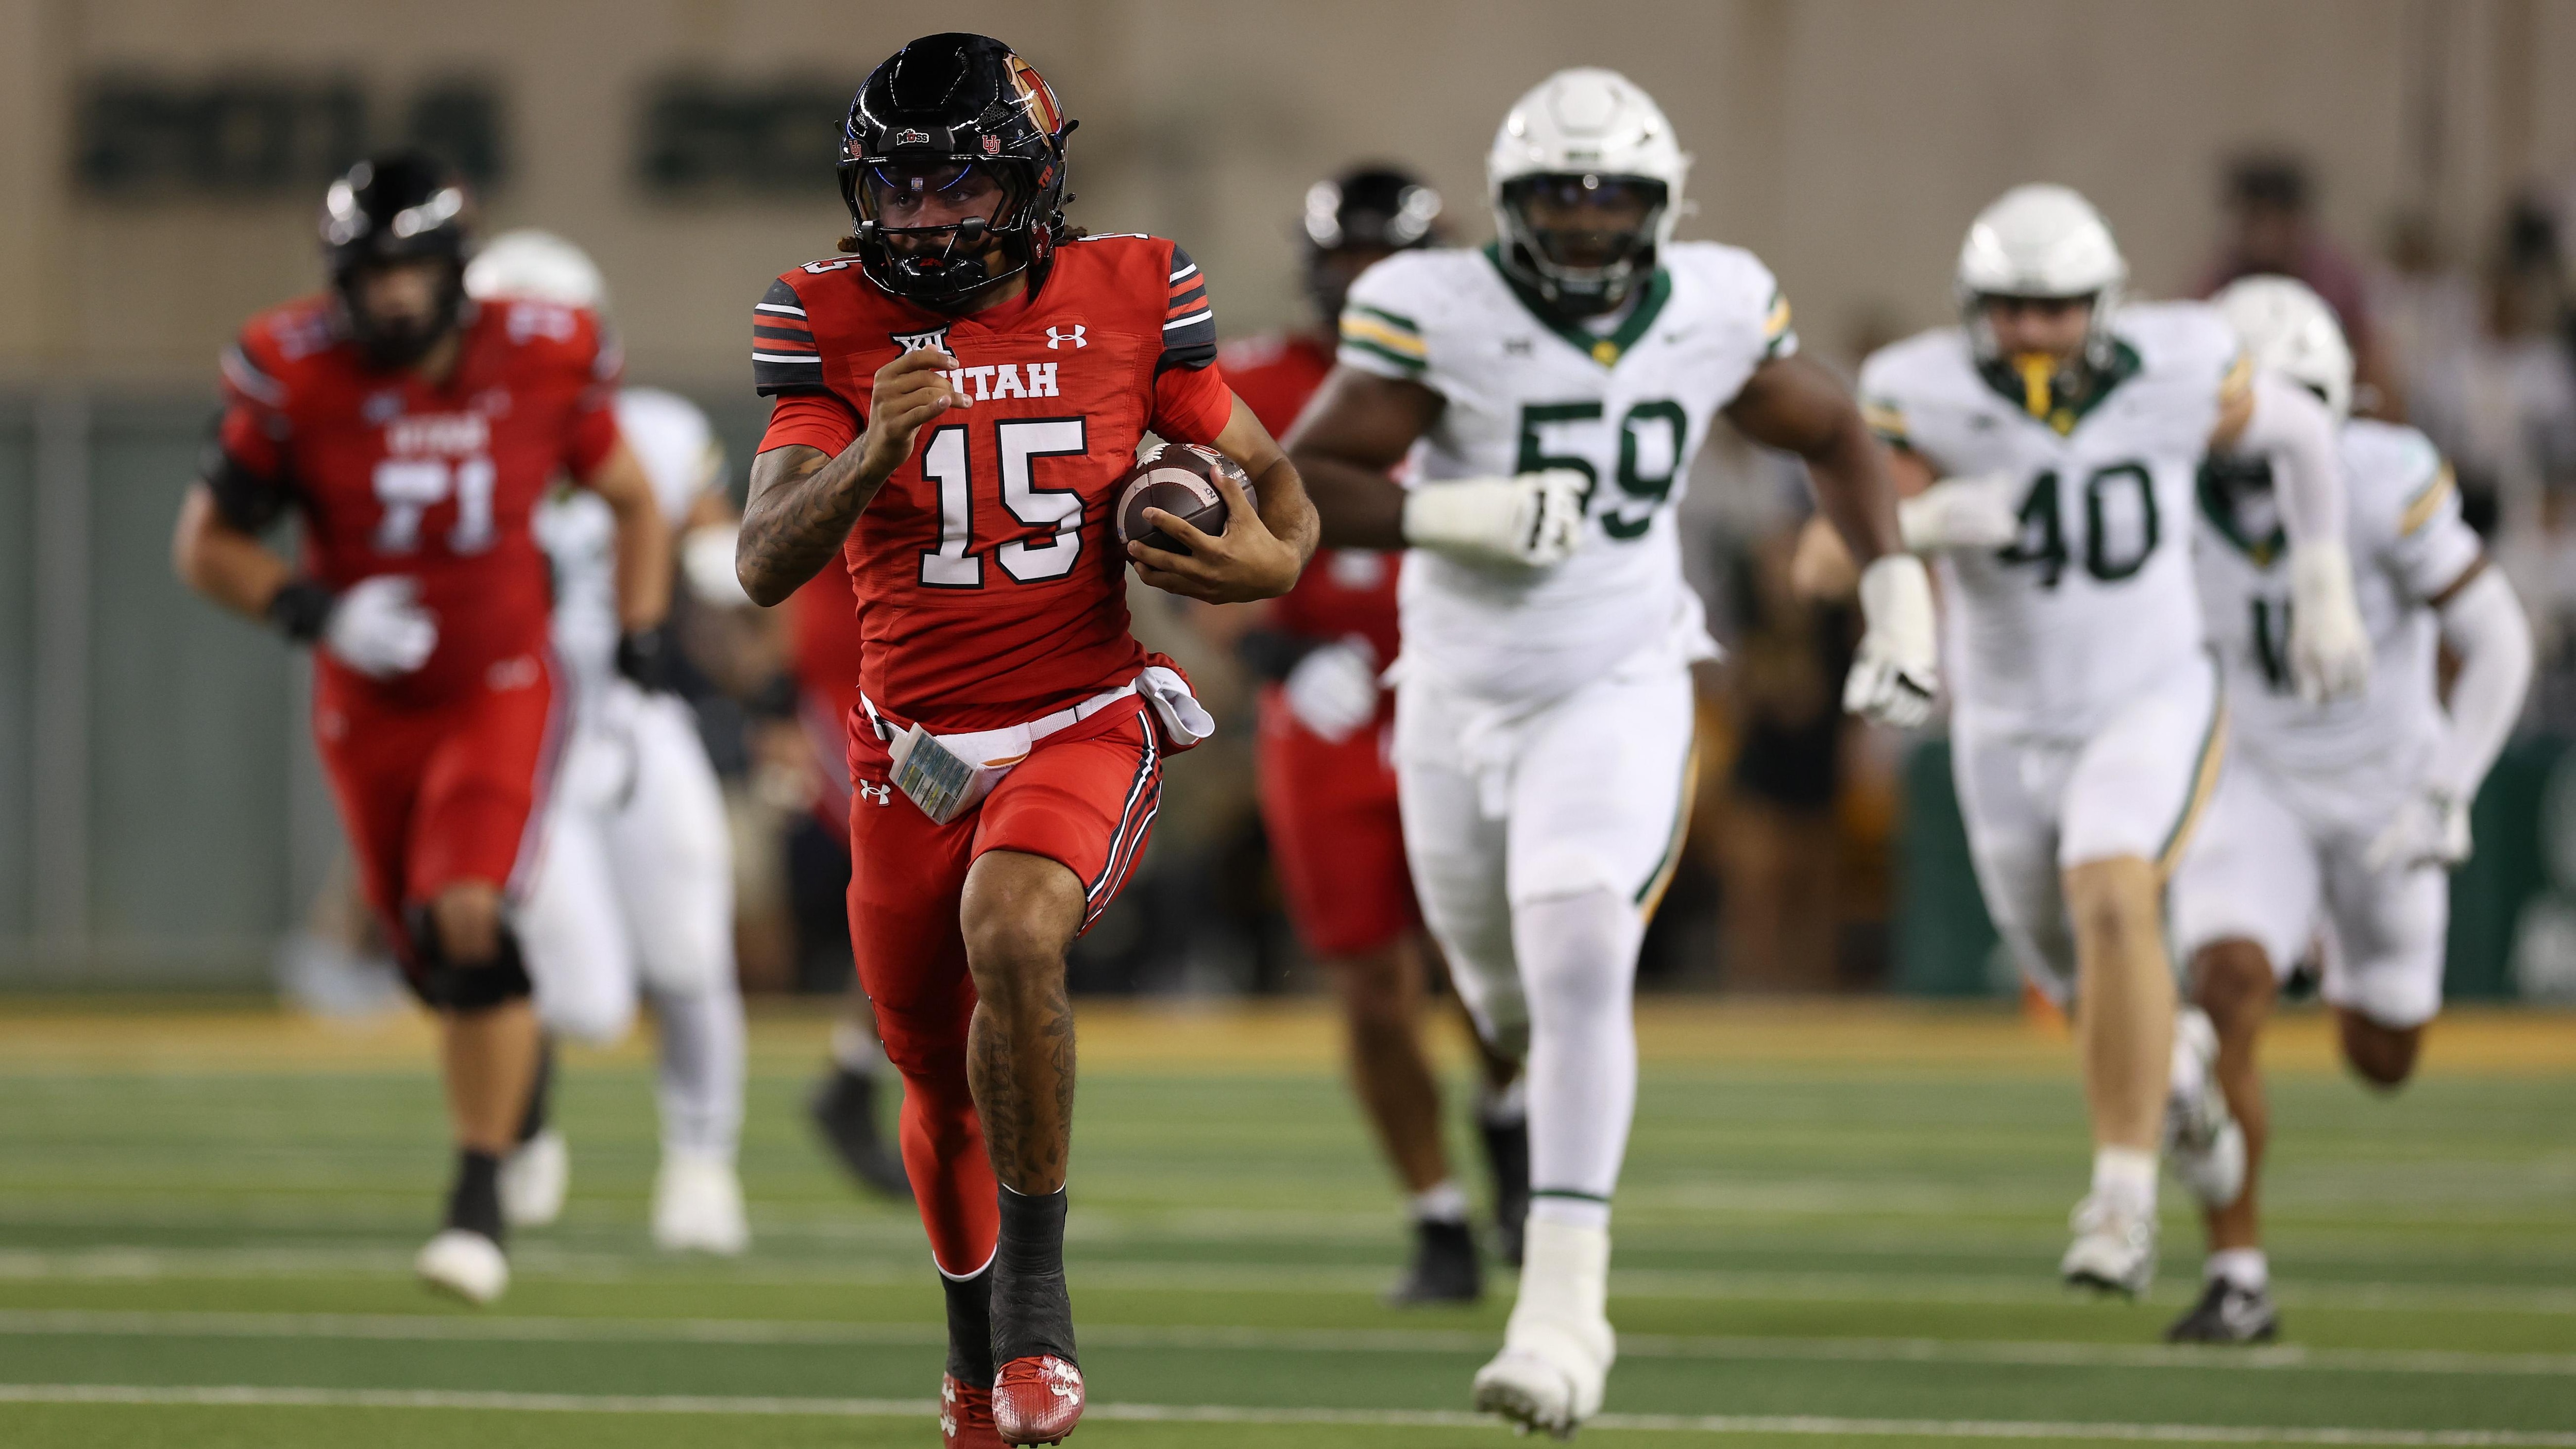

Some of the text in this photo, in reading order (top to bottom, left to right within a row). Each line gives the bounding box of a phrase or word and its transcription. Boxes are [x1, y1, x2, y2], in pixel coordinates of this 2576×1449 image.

[371, 457, 497, 557] 71
[917, 416, 1087, 589] 15
[1518, 400, 1688, 540] 59
[1998, 461, 2160, 591] 40
